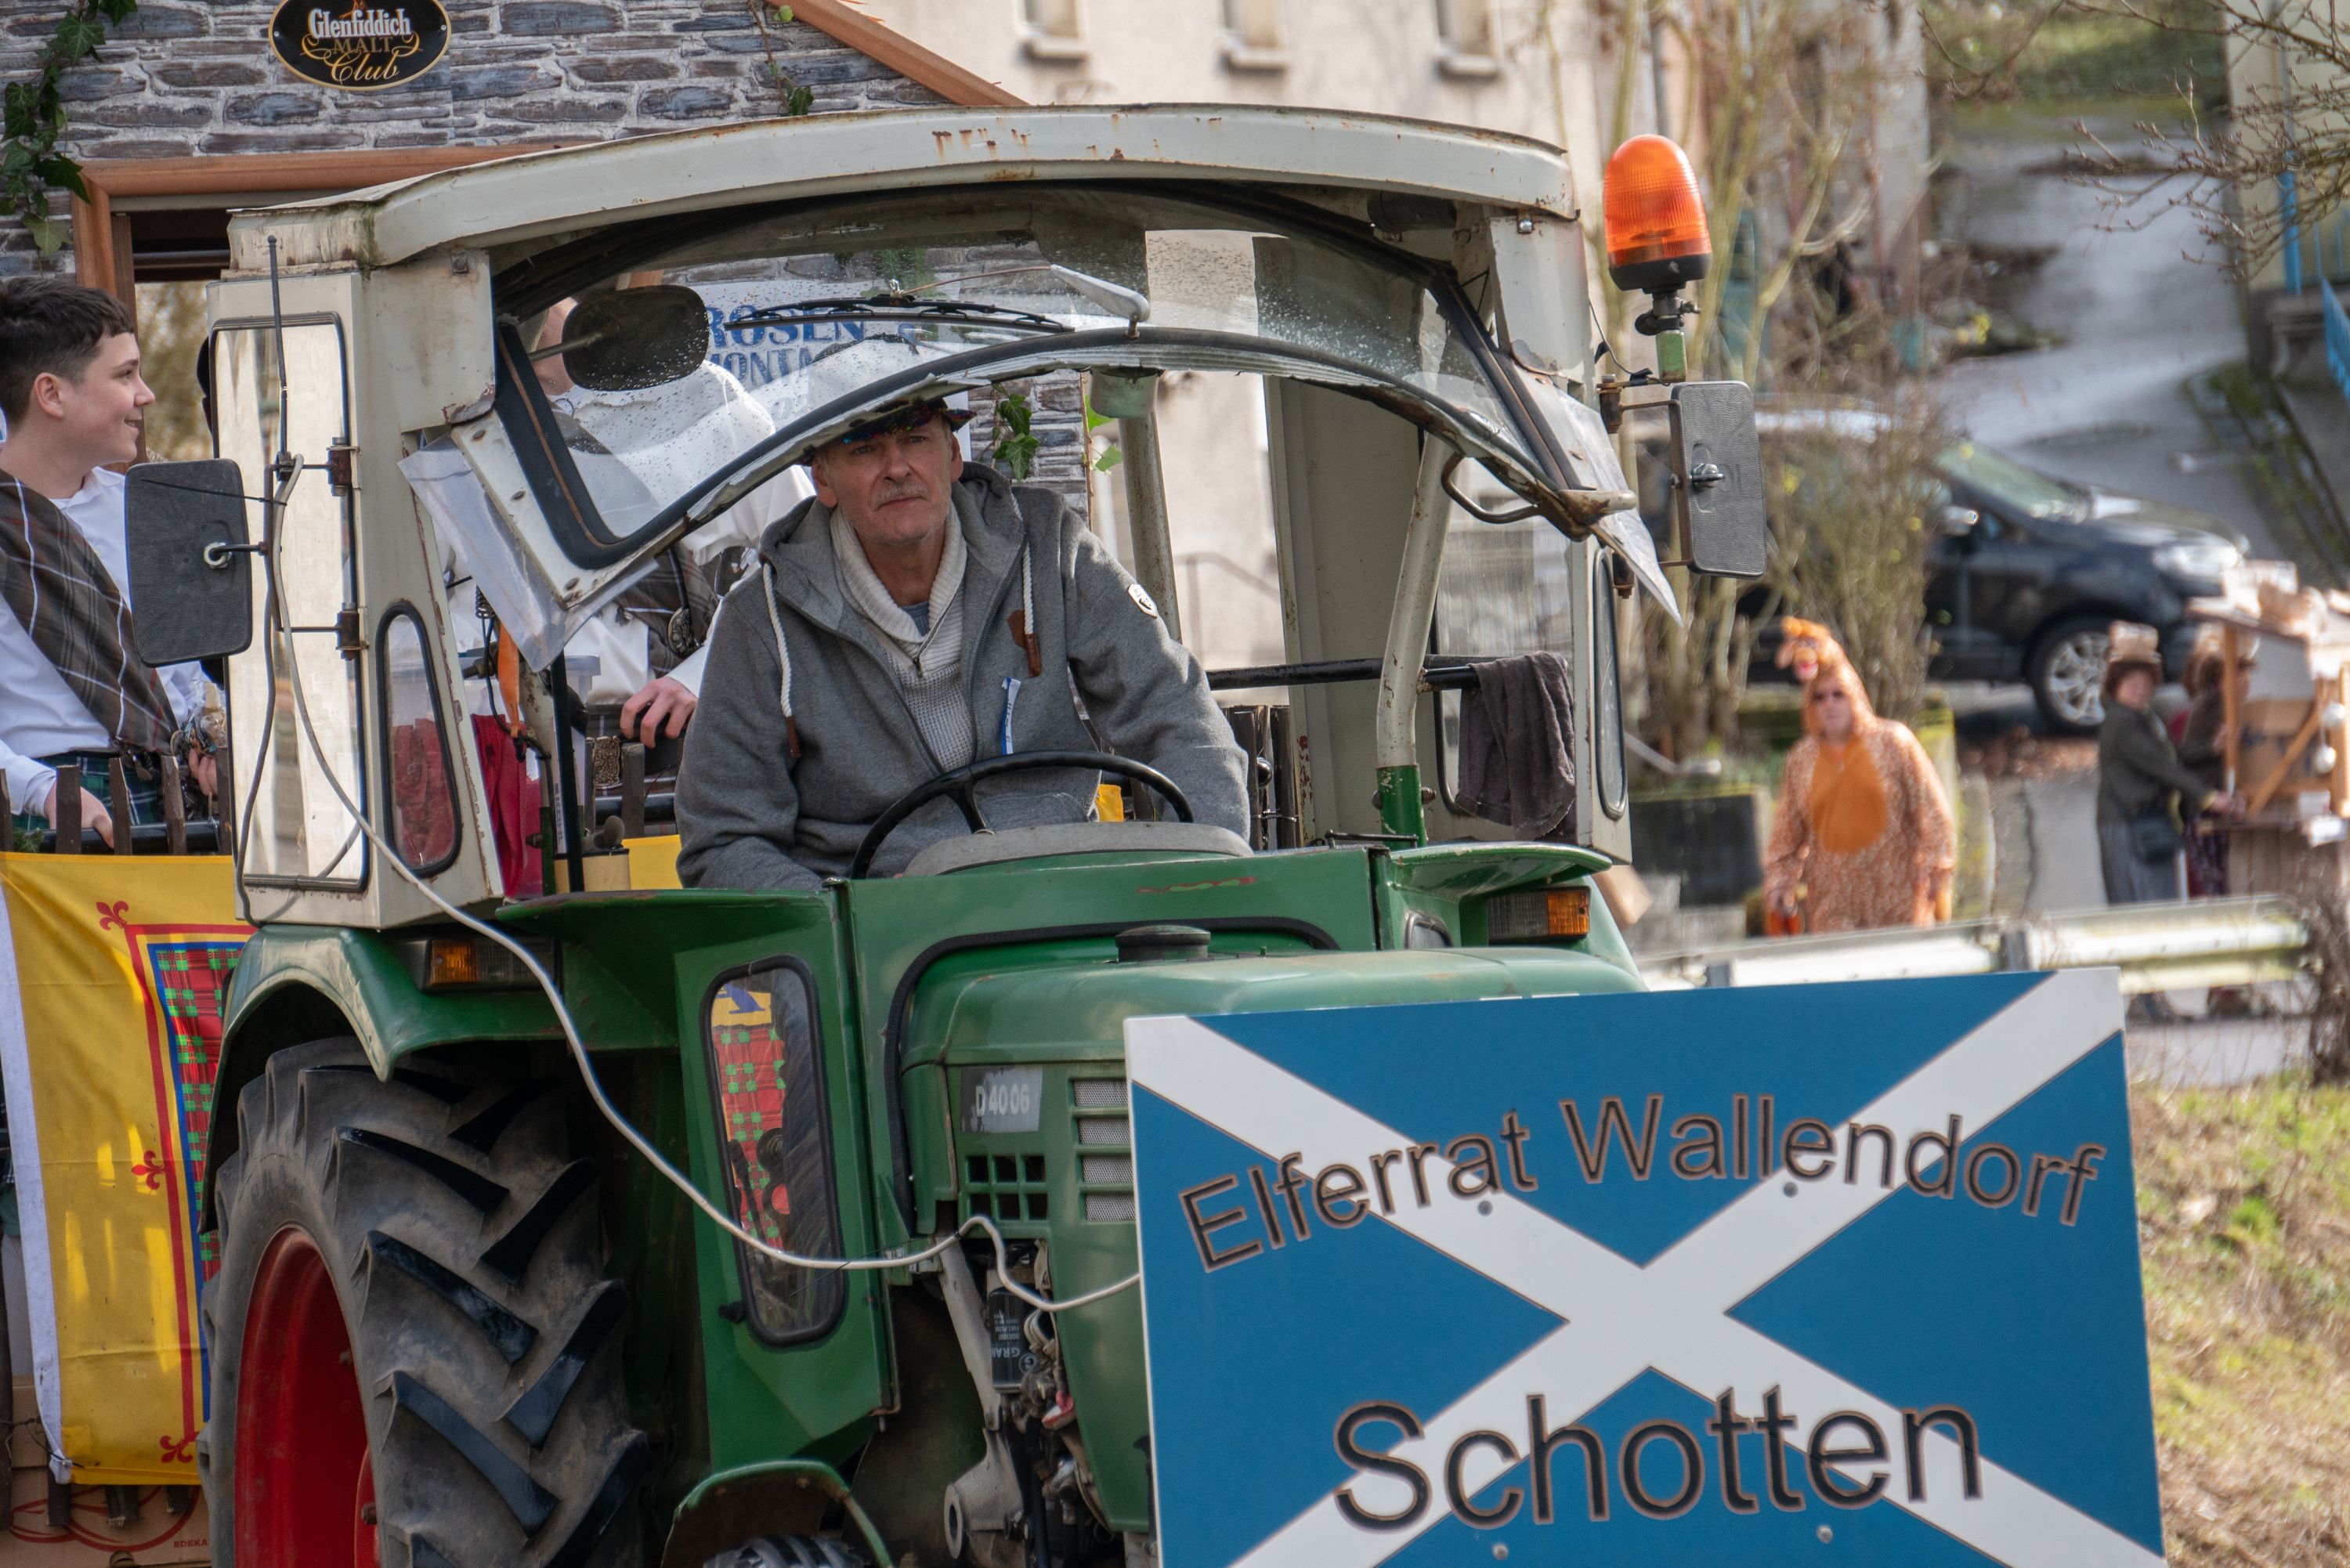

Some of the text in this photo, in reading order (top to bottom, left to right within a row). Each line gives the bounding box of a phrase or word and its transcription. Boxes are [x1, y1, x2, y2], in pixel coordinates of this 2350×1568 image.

[309, 8, 412, 38] Glenfiddich
[333, 37, 393, 55] MALT
[324, 49, 400, 85] Club
[1178, 1093, 2107, 1273] Elferrat Wallendorf
[1332, 1385, 1984, 1534] Schotten
[173, 1539, 208, 1548] EDEKA
